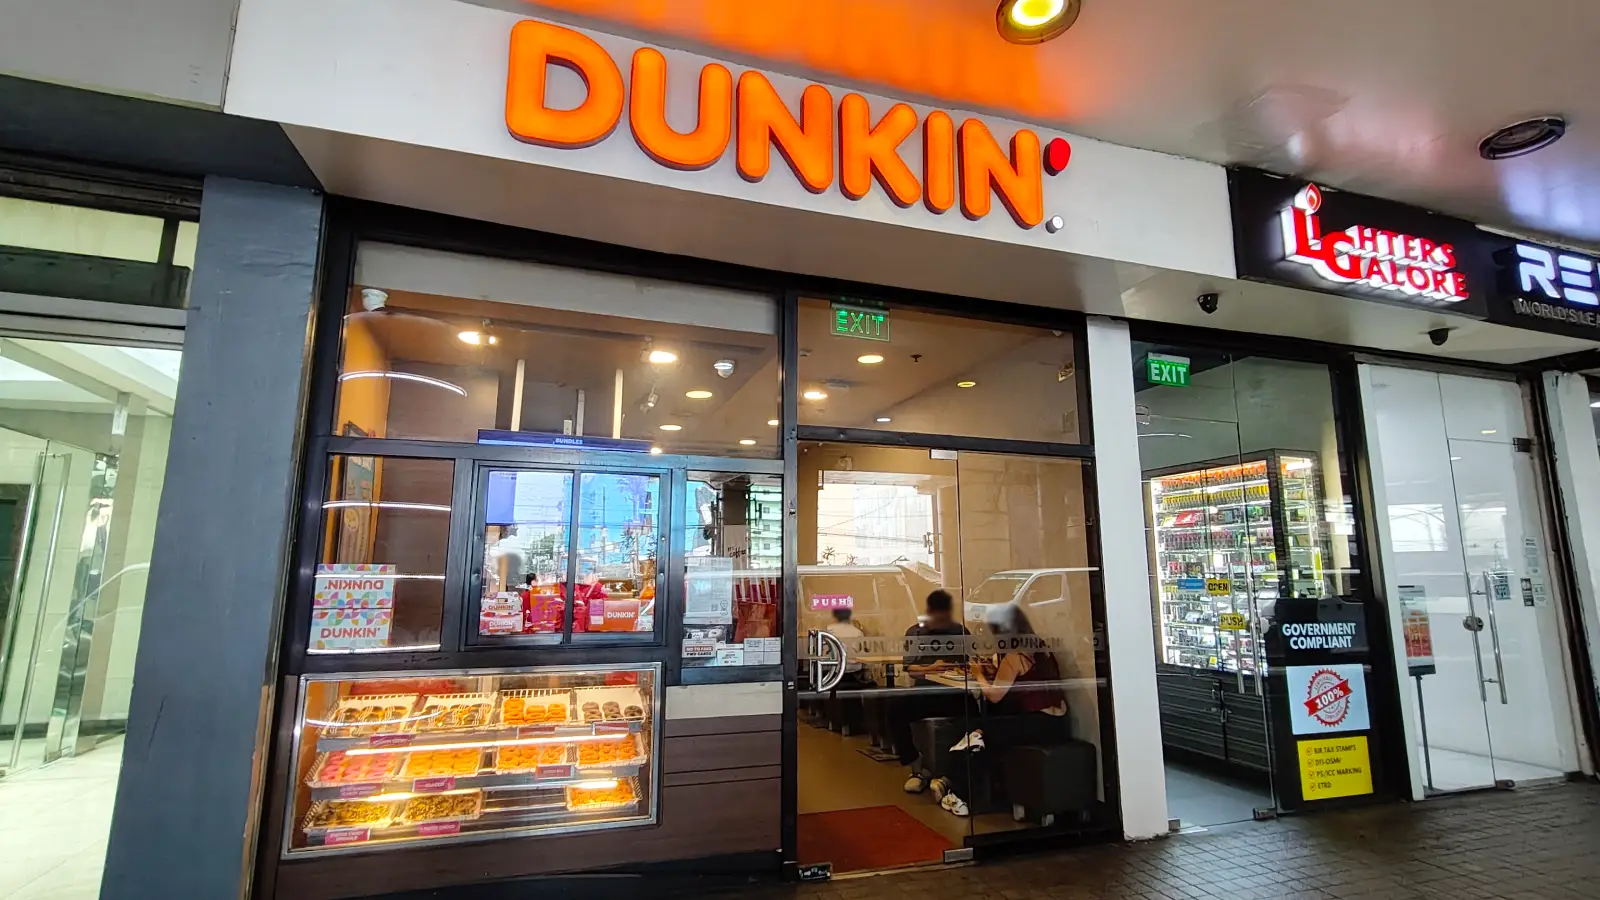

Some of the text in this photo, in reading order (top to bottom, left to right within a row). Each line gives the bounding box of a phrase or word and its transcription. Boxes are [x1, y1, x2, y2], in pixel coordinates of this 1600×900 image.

[505, 19, 1071, 230] DUNKIN'
[1516, 244, 1600, 306] RE
[1513, 300, 1577, 323] WORLD'S
[836, 310, 884, 335] EXIT
[1150, 362, 1187, 384] EXIT
[555, 437, 583, 445] BUNDLES
[324, 579, 384, 590] DUNKIN'
[1208, 582, 1228, 592] OPEN
[812, 598, 848, 607] PUSH
[606, 611, 636, 619] DUNKIN'
[1220, 616, 1244, 627] PUSH
[321, 628, 381, 638] DUNKIN'
[1282, 622, 1357, 636] GOVERNMENT
[1290, 635, 1352, 649] COMPLIANT
[1315, 687, 1344, 709] 100%
[1335, 744, 1357, 752] STAMPS
[1336, 767, 1362, 776] MARKING
